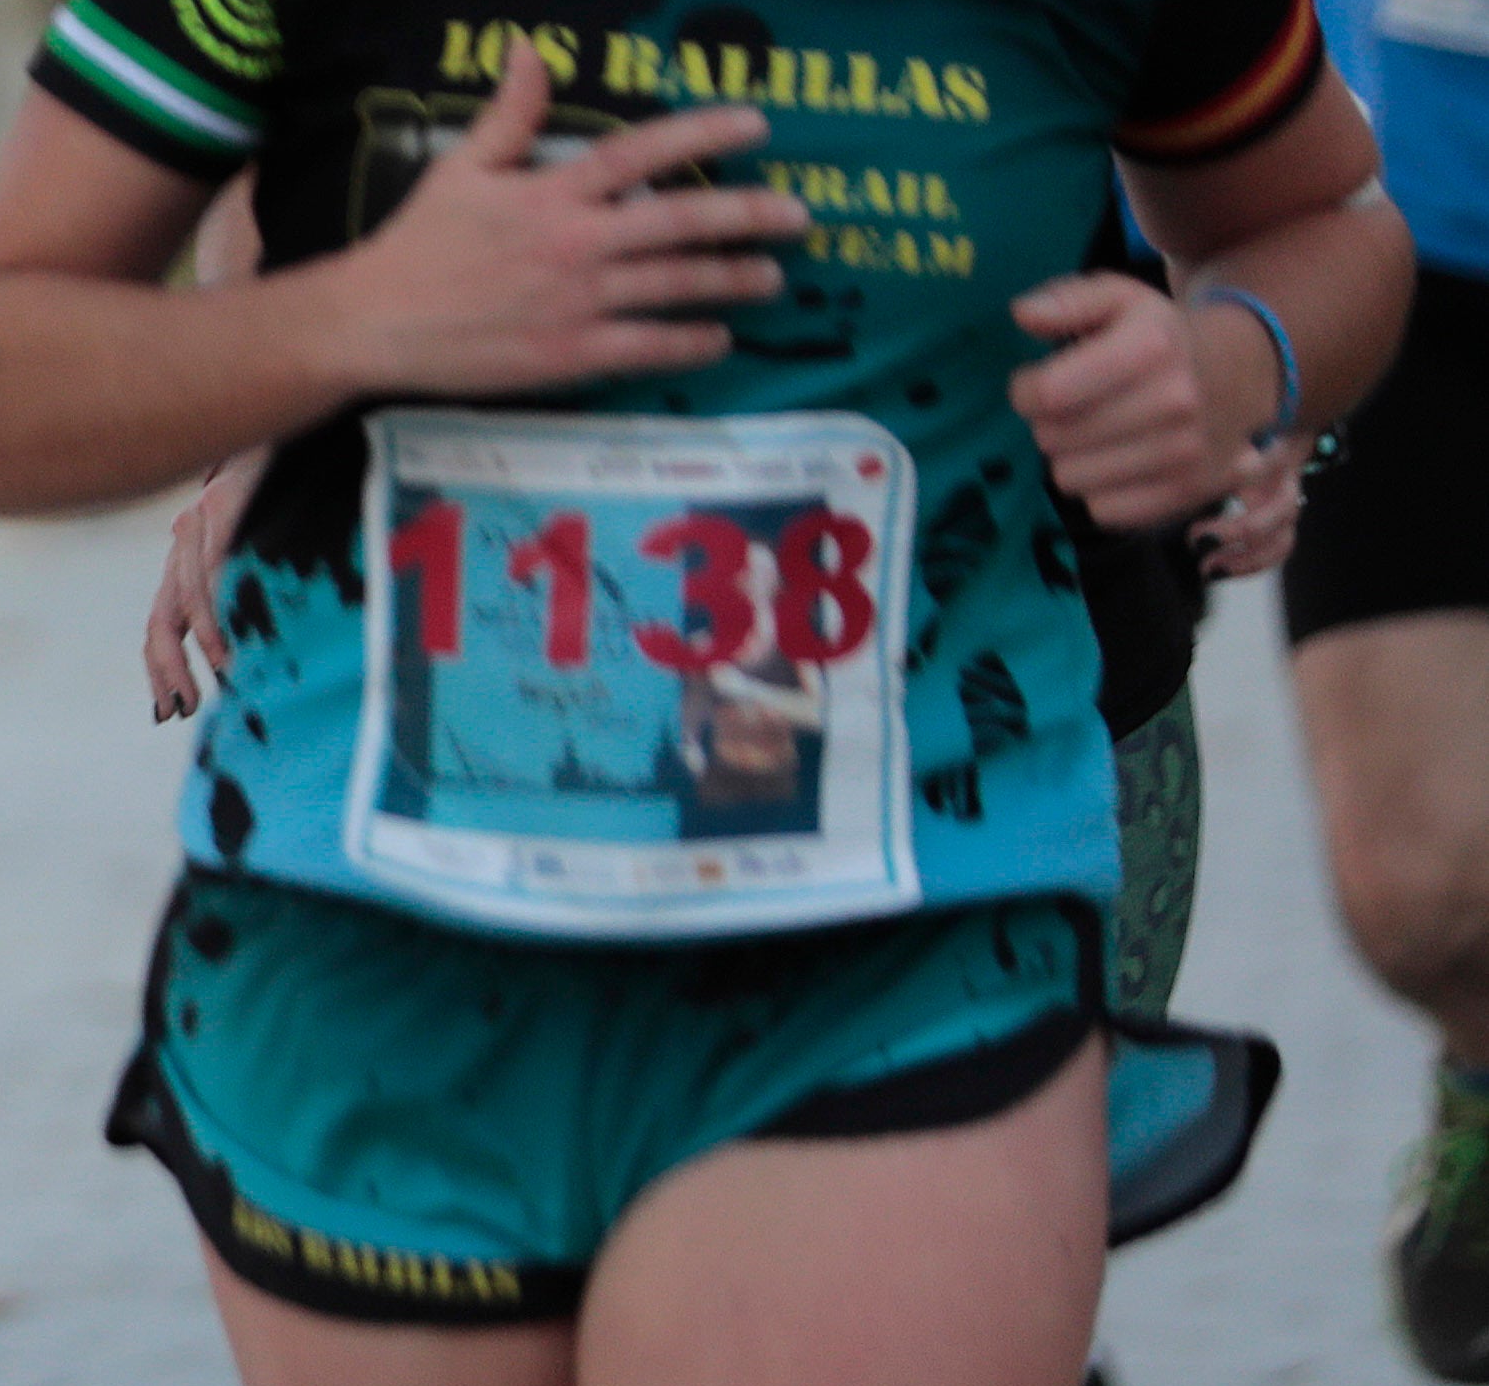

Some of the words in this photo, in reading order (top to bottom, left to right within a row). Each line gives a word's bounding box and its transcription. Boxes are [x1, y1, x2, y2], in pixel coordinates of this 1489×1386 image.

[438, 18, 580, 88] LOS
[602, 29, 990, 124] BALILLAS
[759, 159, 961, 221] TRAIL
[388, 501, 876, 677] 1138
